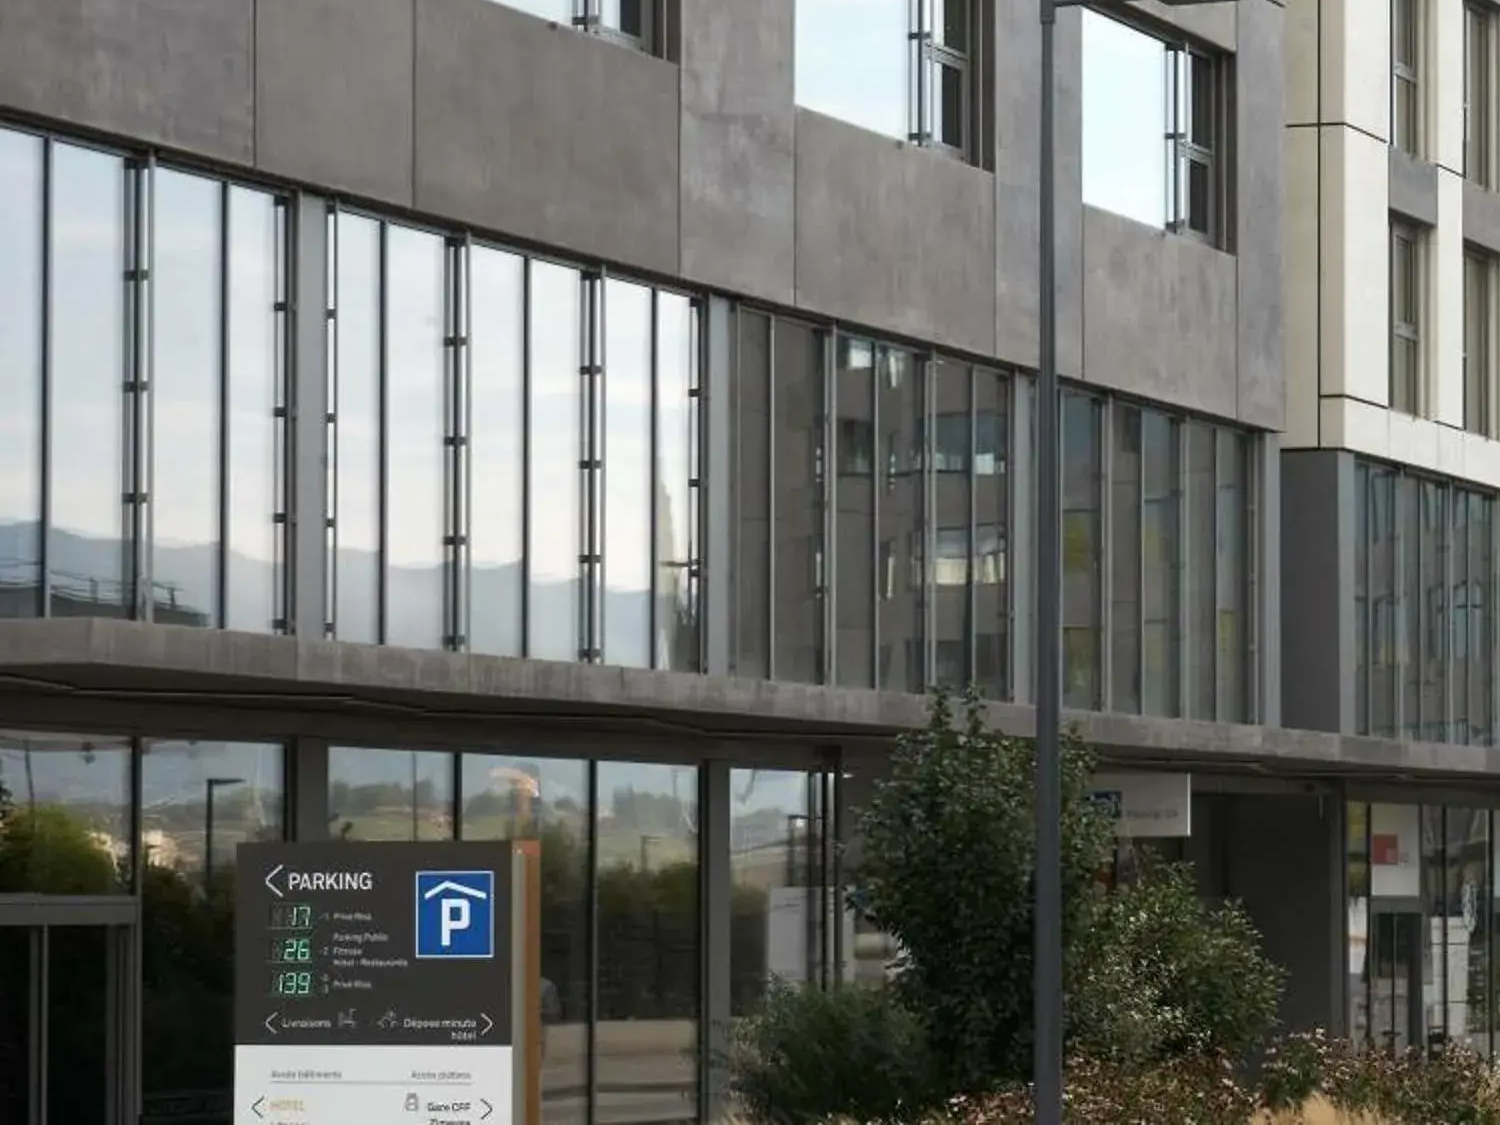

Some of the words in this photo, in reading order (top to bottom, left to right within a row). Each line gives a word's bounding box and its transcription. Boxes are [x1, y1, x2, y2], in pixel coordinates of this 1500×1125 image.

[288, 872, 373, 890] PARKING
[441, 898, 471, 947] P
[283, 938, 311, 960] 26
[279, 972, 311, 994] 139
